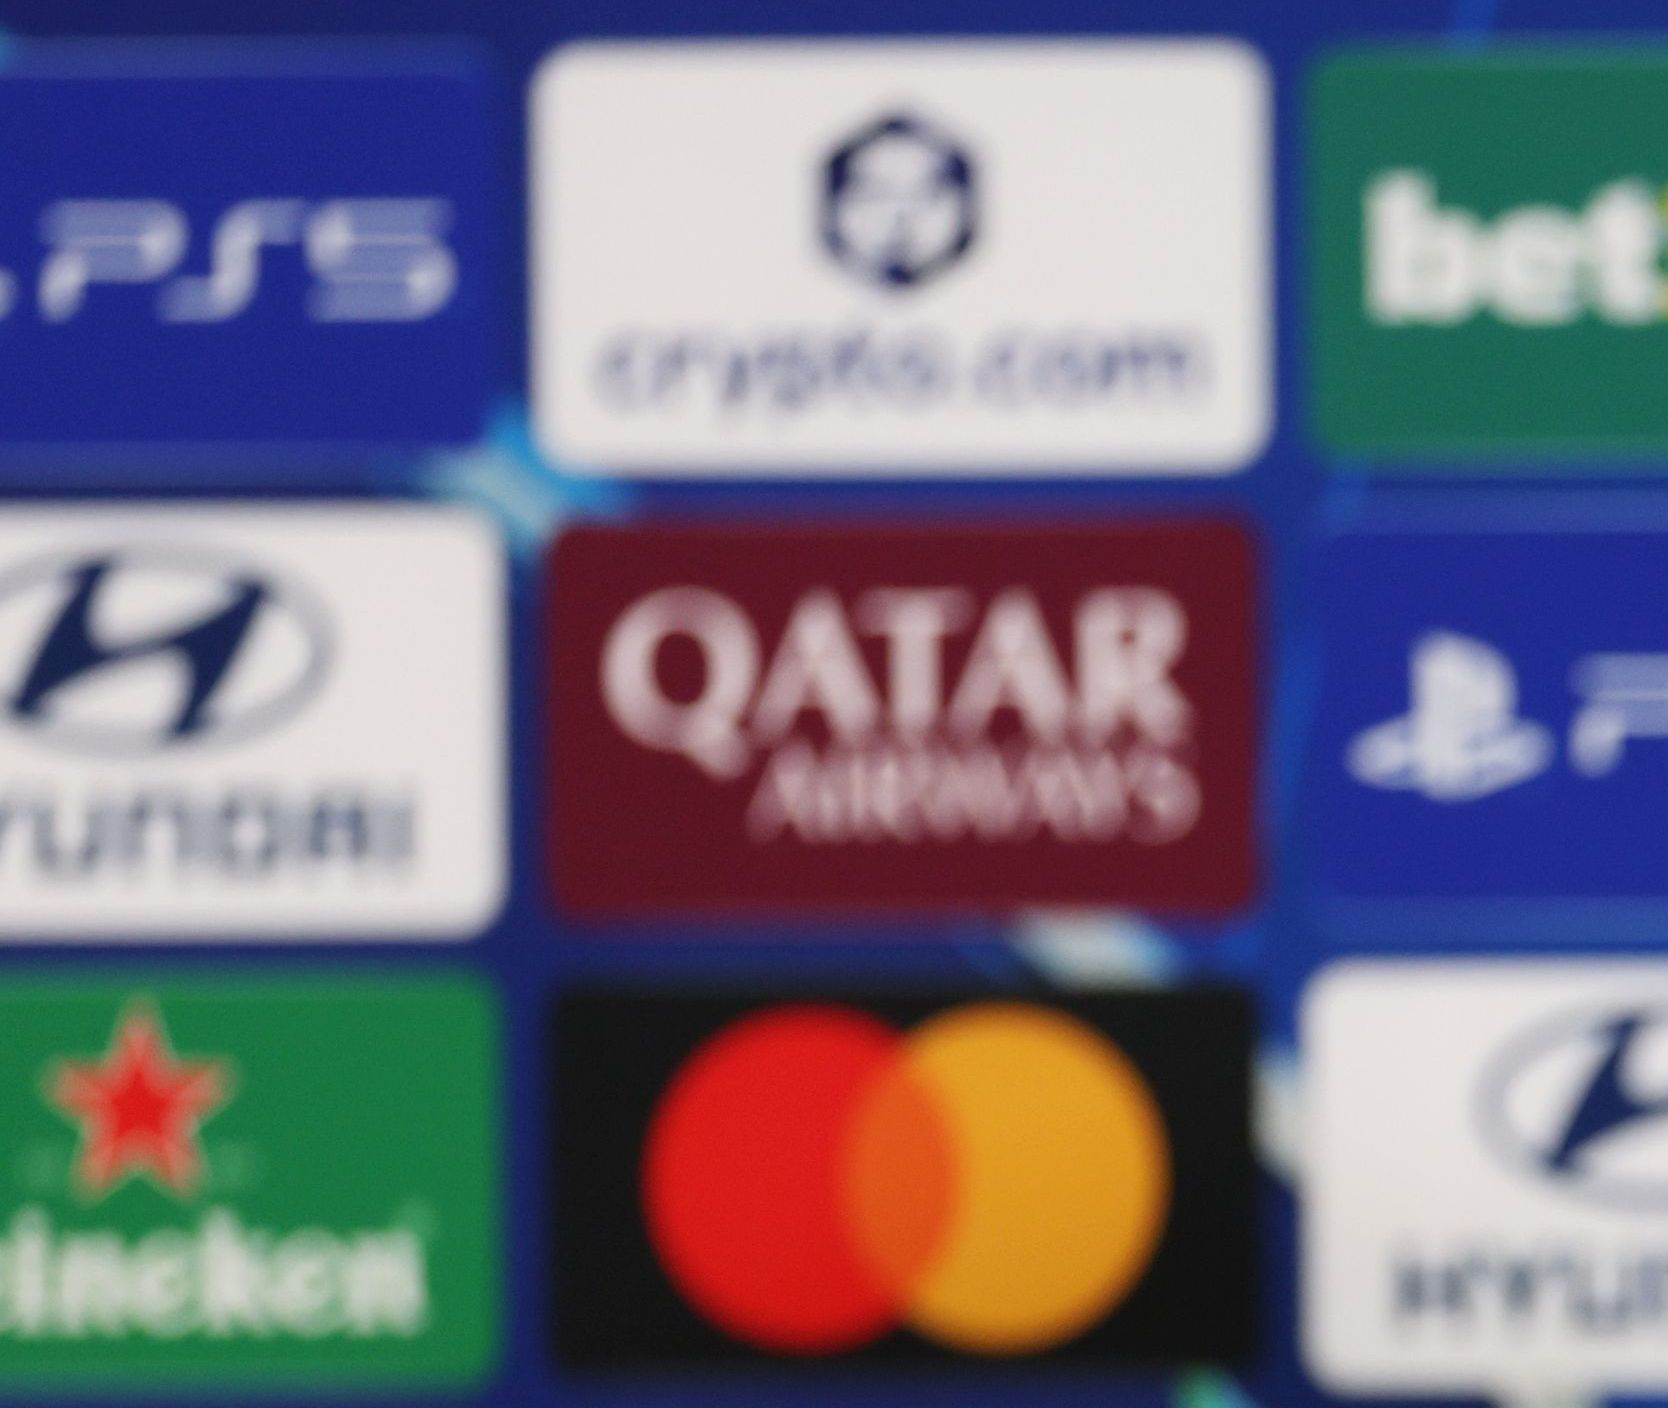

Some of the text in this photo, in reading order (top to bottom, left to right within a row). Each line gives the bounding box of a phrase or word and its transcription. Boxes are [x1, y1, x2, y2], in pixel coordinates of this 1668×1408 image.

[42, 199, 458, 323] PS5
[597, 330, 1212, 420] crypto.com
[602, 586, 1195, 779] QATAR
[746, 738, 1202, 844] AIRWAYS
[0, 1205, 426, 1338] ineken
